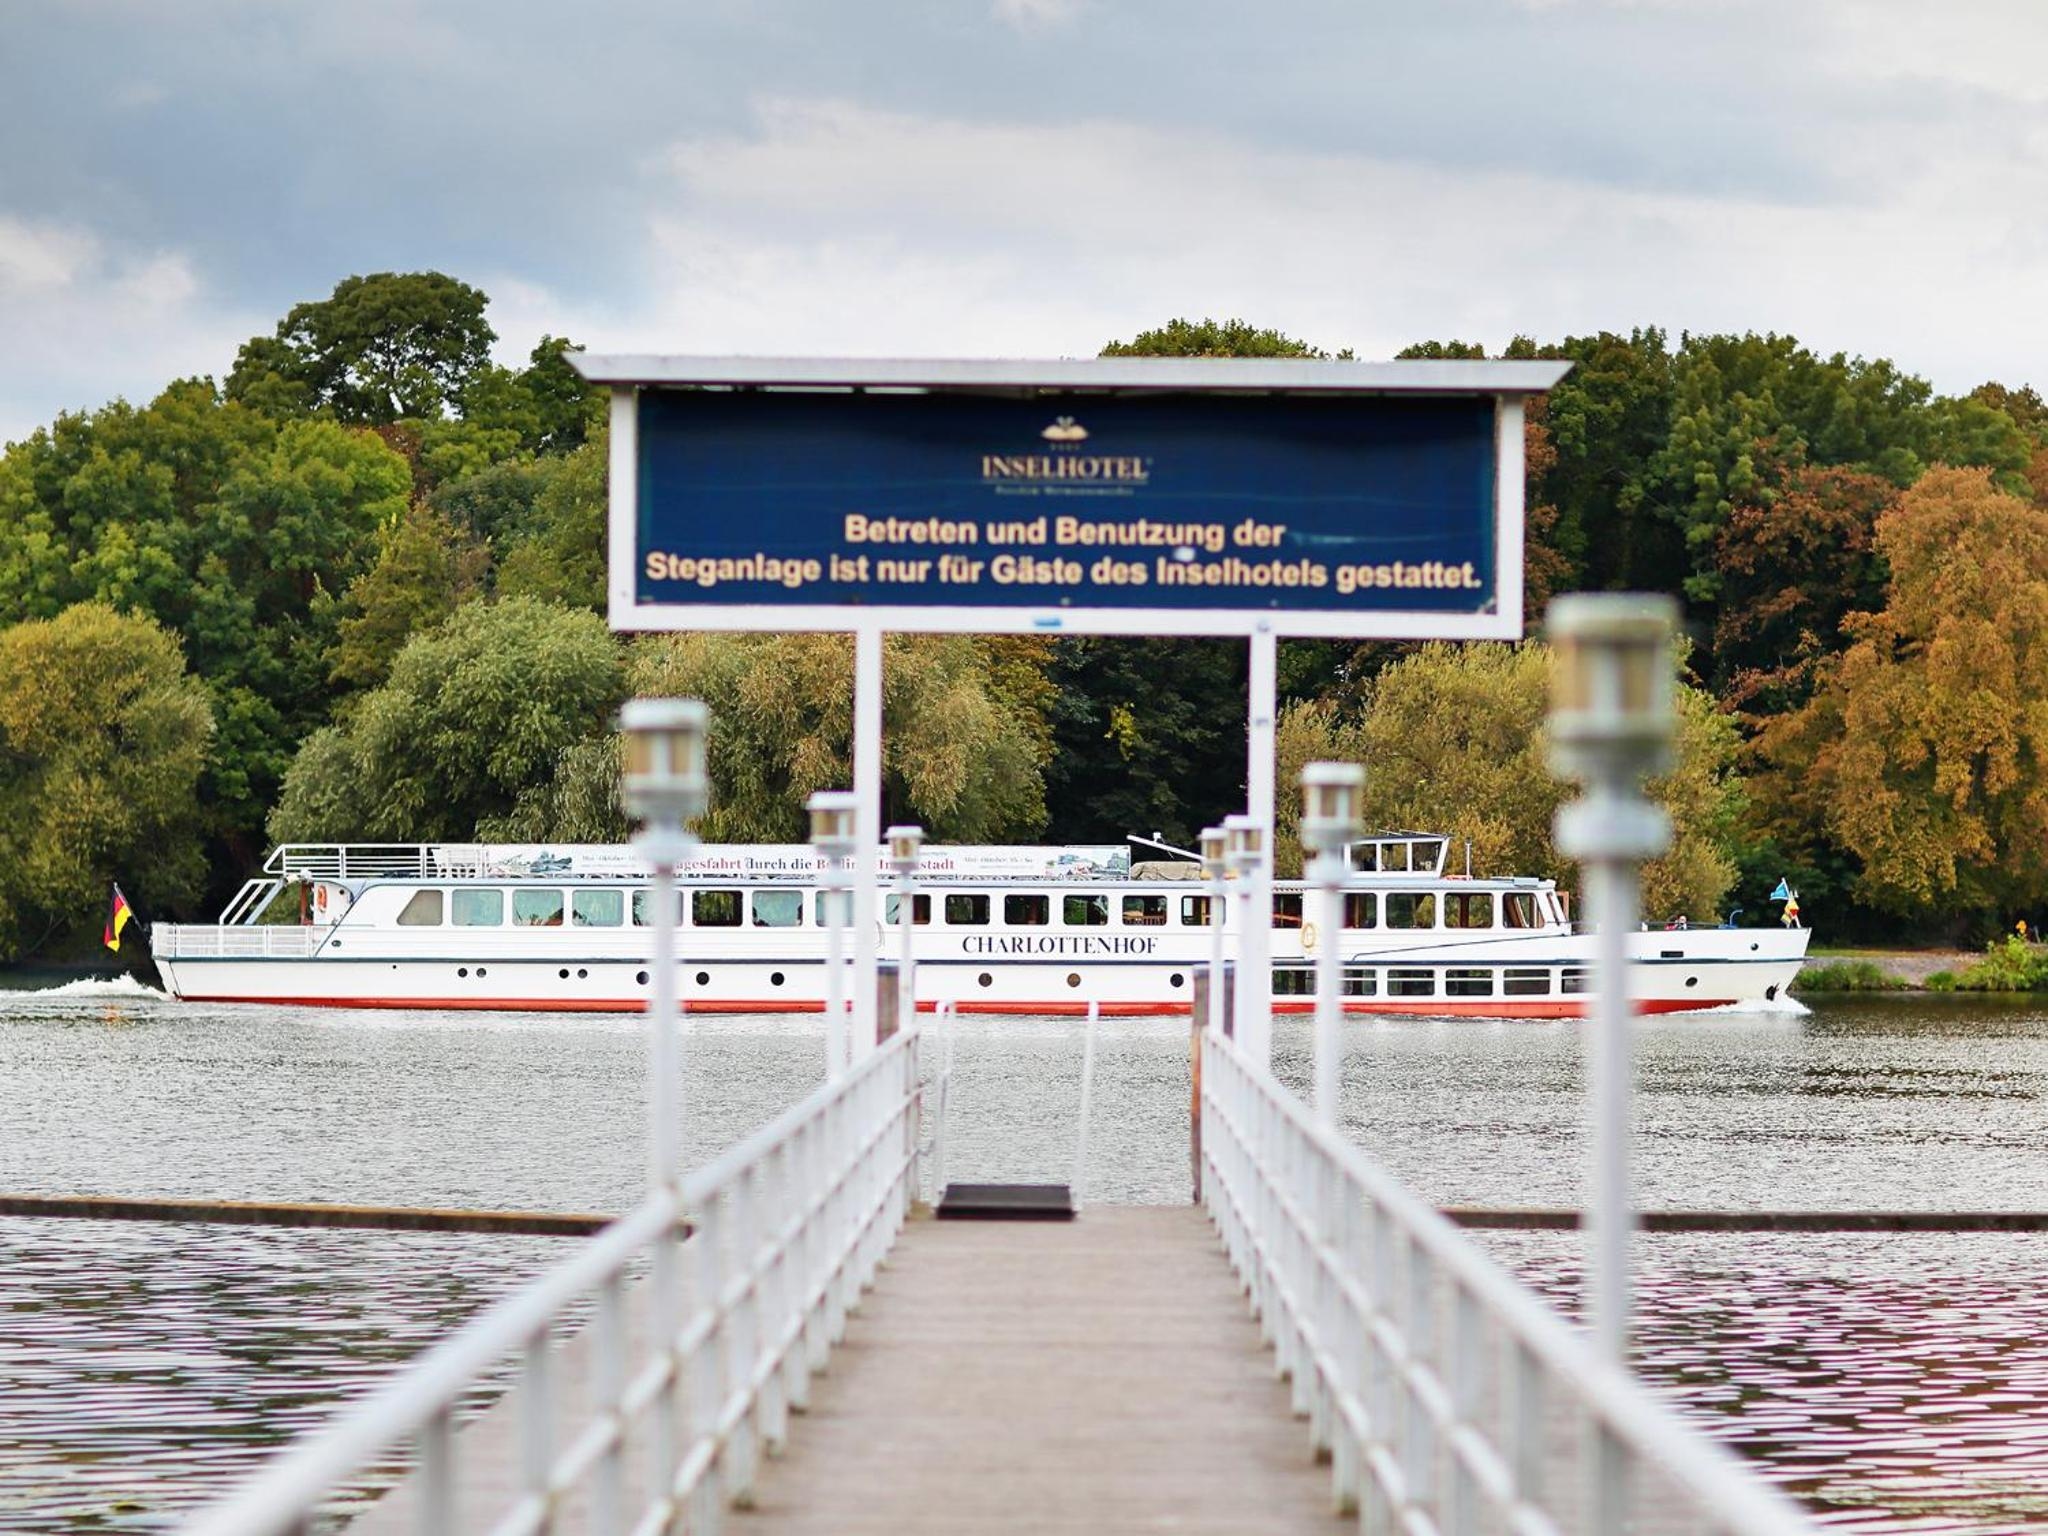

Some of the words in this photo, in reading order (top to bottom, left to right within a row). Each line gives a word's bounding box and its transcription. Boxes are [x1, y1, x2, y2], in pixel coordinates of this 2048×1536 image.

[845, 514, 978, 544] Betreten
[986, 517, 1047, 545] und
[1055, 516, 1225, 551] Benutzung
[1233, 518, 1286, 547] der
[646, 551, 822, 588] Steganlage
[830, 553, 869, 582] ist
[877, 560, 932, 583] nur
[938, 554, 984, 583] für
[990, 554, 1083, 585] Gäste
[1090, 556, 1148, 585] des
[1156, 557, 1328, 588] Inselhotels
[1336, 560, 1482, 594] gestattet.
[676, 857, 742, 870] agesfahrt
[747, 857, 786, 870] durch
[791, 857, 812, 870] die
[962, 935, 1159, 955] CHARLOTTENHOF
